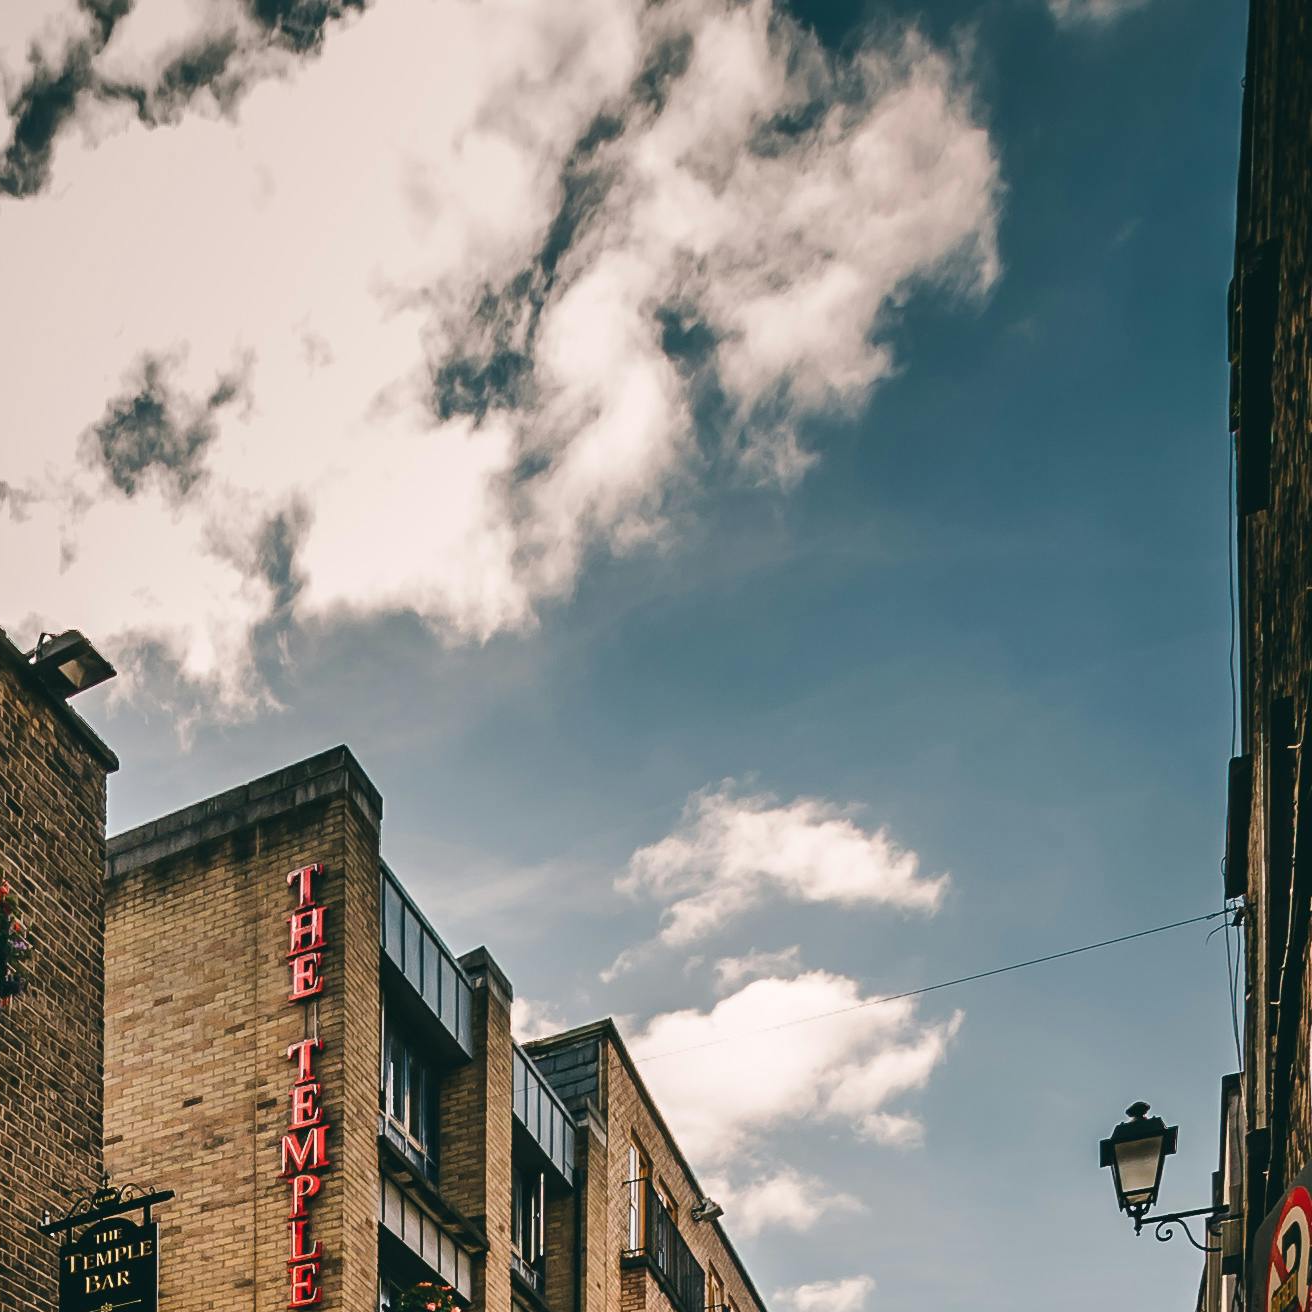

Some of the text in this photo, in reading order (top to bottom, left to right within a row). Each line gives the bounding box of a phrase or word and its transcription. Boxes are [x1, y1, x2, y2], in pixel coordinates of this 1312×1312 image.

[286, 863, 328, 1001] THE
[280, 1039, 331, 1307] TEMPLE
[94, 1228, 123, 1245] THE
[65, 1240, 153, 1274] TEMPLE
[85, 1270, 132, 1294] BAR
